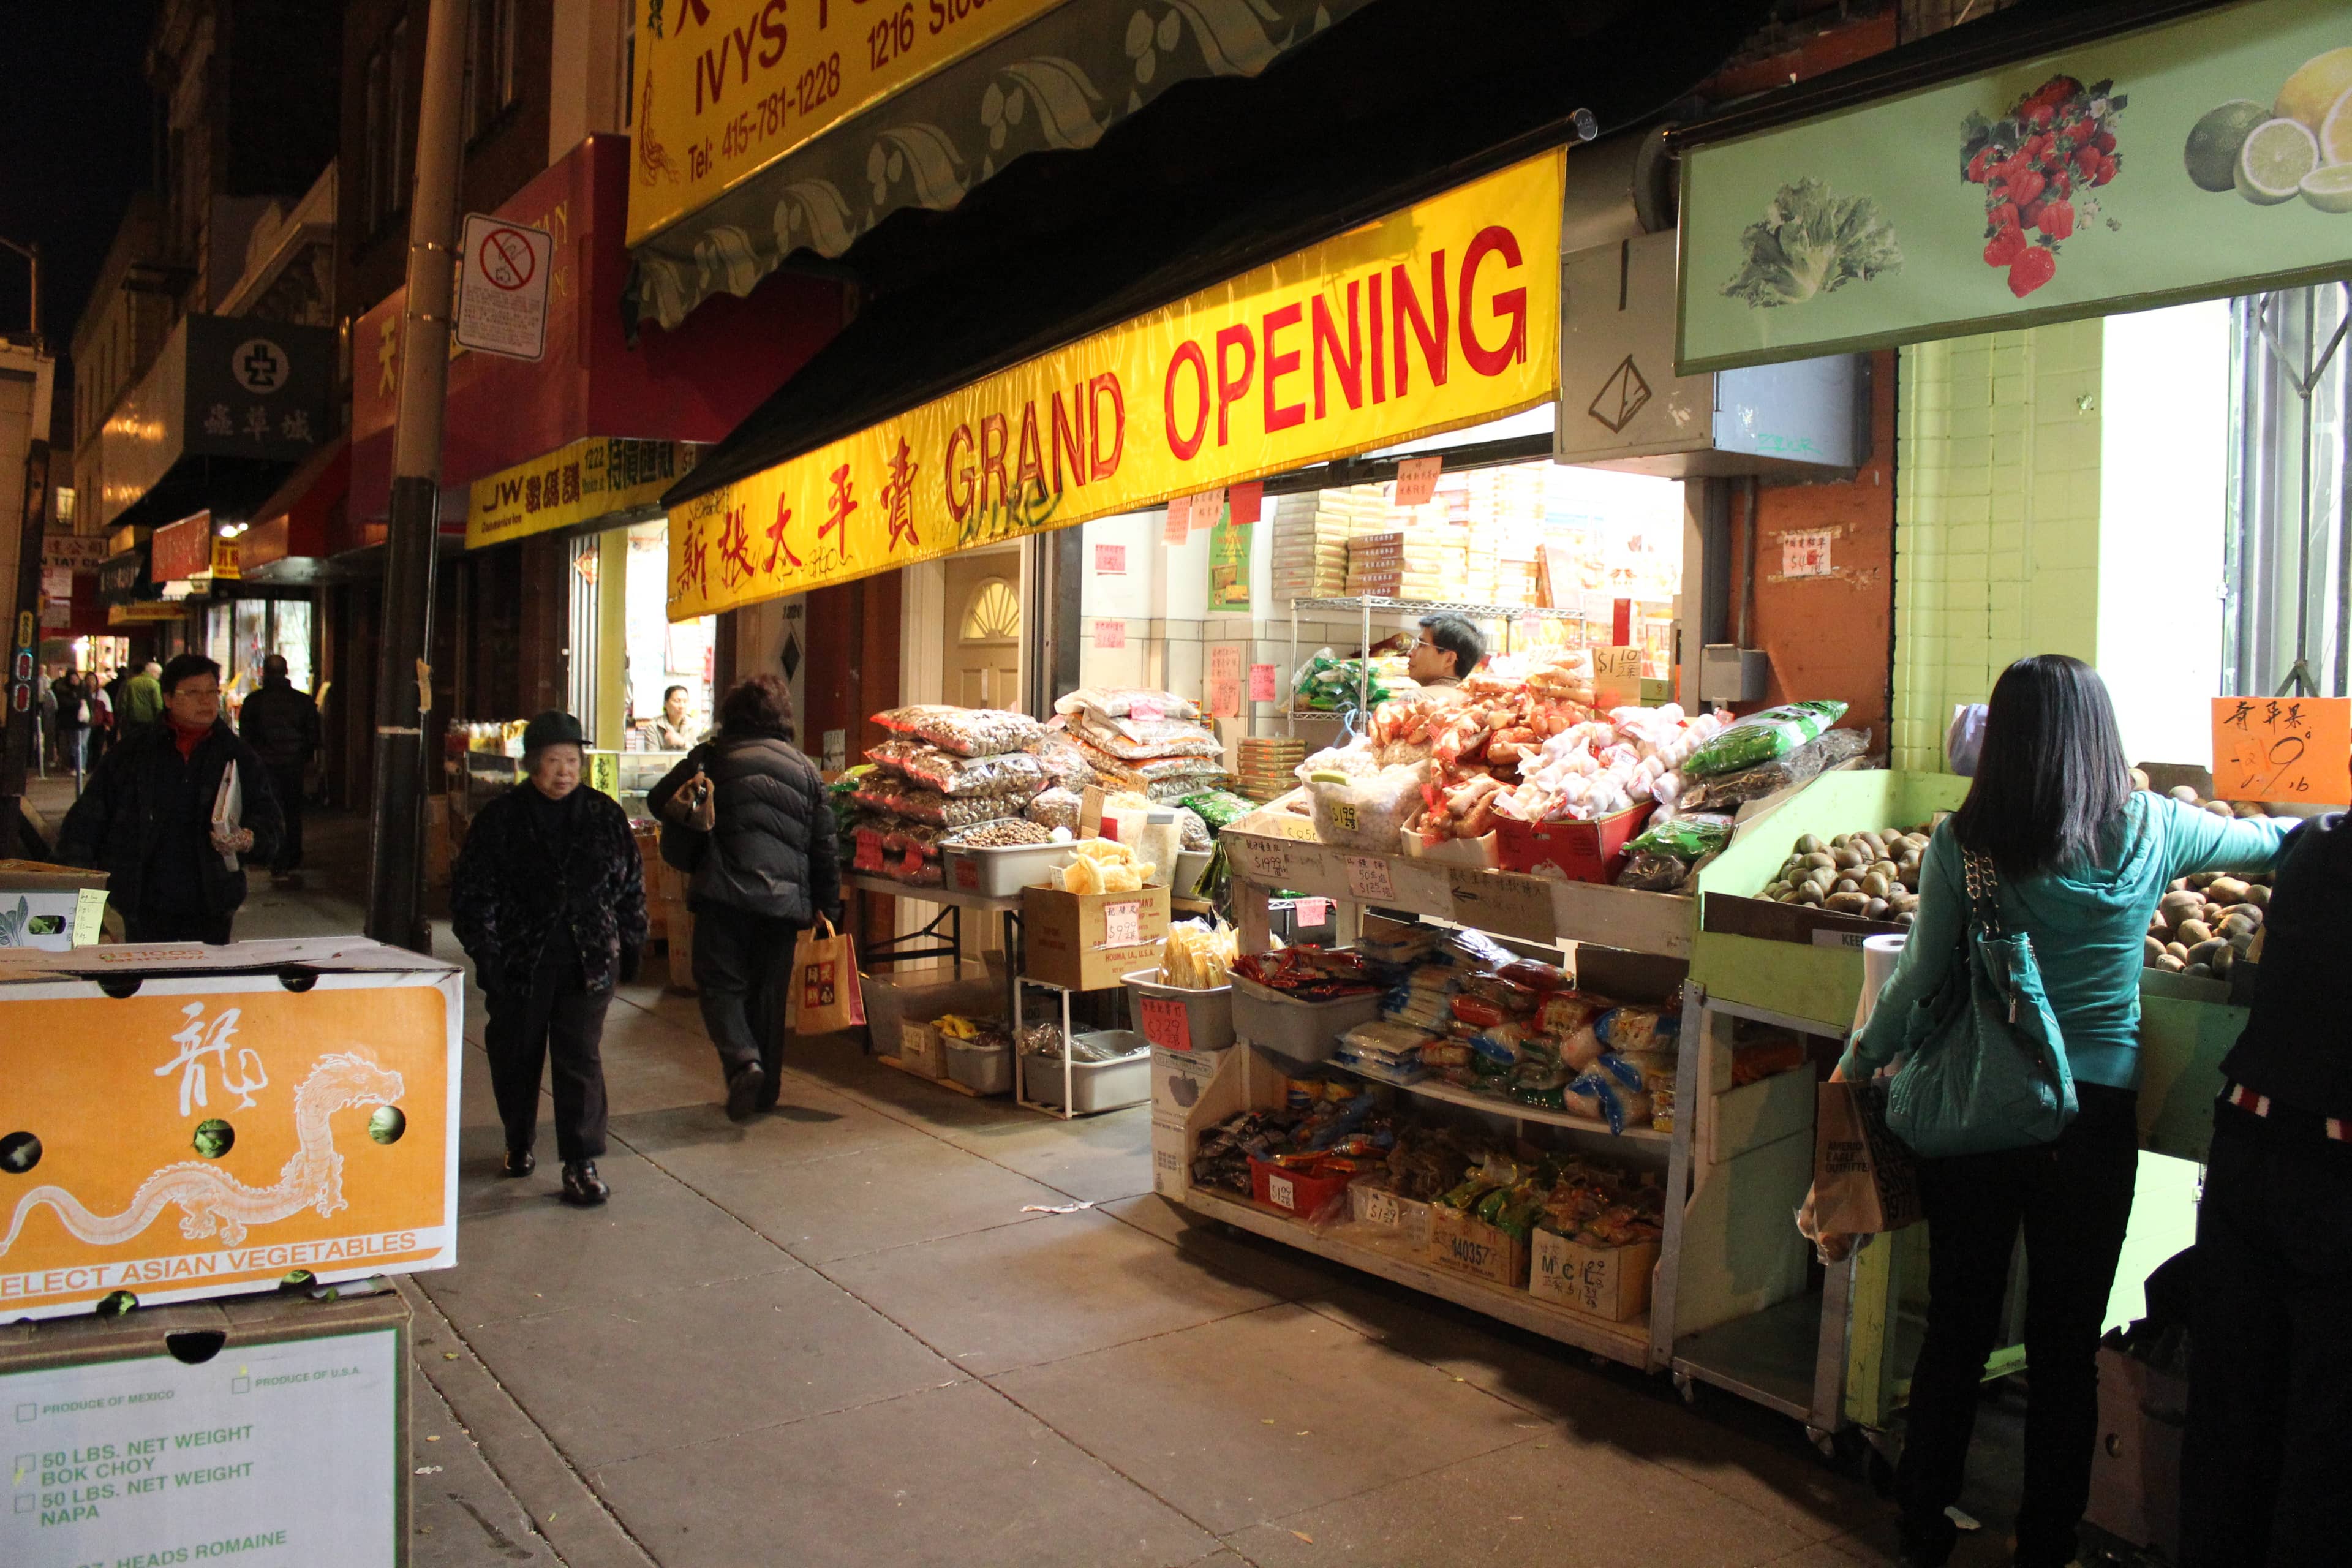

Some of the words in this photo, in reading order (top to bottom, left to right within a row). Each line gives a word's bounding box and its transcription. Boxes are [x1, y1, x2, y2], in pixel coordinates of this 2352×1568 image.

[695, 0, 788, 115] IVYS
[688, 135, 713, 182] Tel:
[722, 51, 840, 161] 415-781-1228
[867, 3, 915, 72] 1216
[946, 371, 1125, 522] GRAND
[1164, 225, 1527, 461] OPENING
[482, 475, 524, 513] JW
[1827, 1141, 1864, 1151] AMERIC
[1826, 1163, 1868, 1172] OUTFITTE
[119, 1255, 217, 1284] ASIAN
[228, 1232, 417, 1268] VEGETABLES
[255, 1372, 310, 1387] PRODUCE
[313, 1369, 328, 1381] OF
[43, 1398, 105, 1415] PRODUCE
[108, 1396, 125, 1406] OF
[129, 1389, 175, 1403] MEXICO
[42, 1452, 66, 1469] 50
[74, 1444, 120, 1465] LBS.
[127, 1437, 168, 1457] NET
[175, 1425, 254, 1450] WEIGHT
[42, 1466, 88, 1487] BOK
[96, 1457, 157, 1480] CHOY
[42, 1490, 66, 1508] 50
[73, 1481, 120, 1504] LBS.
[127, 1475, 168, 1494] NET
[175, 1462, 254, 1487] WEIGHT
[41, 1505, 99, 1527] NAPA
[117, 1547, 189, 1568] HEADS
[195, 1529, 288, 1558] ROMAINE
